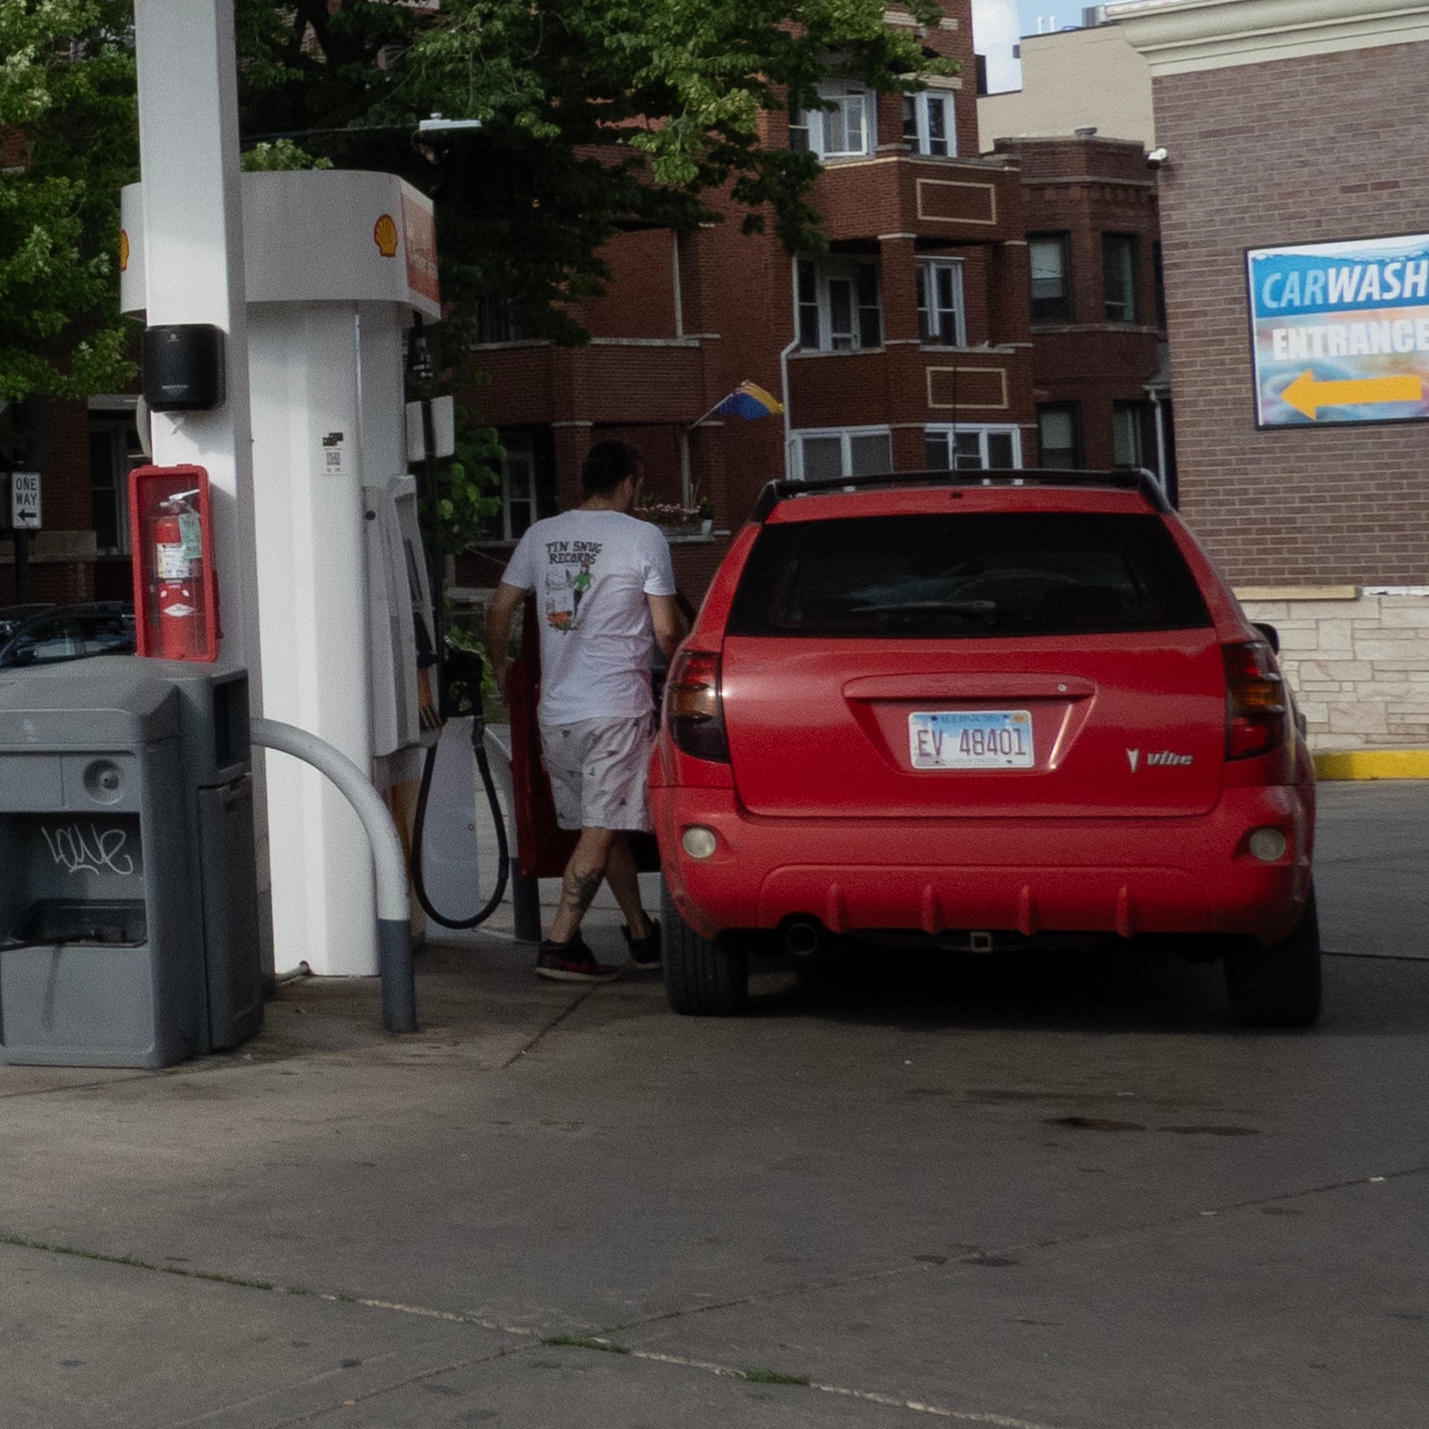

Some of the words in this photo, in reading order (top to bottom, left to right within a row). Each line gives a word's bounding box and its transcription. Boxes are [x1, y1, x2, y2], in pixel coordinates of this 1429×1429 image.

[1272, 317, 1429, 362] ENTRANCE
[15, 478, 37, 491] ONE
[15, 492, 37, 506] WAY
[545, 540, 569, 554] TIN
[548, 552, 598, 565] RECORDS
[917, 729, 944, 758] EV
[959, 727, 1027, 757] 48401
